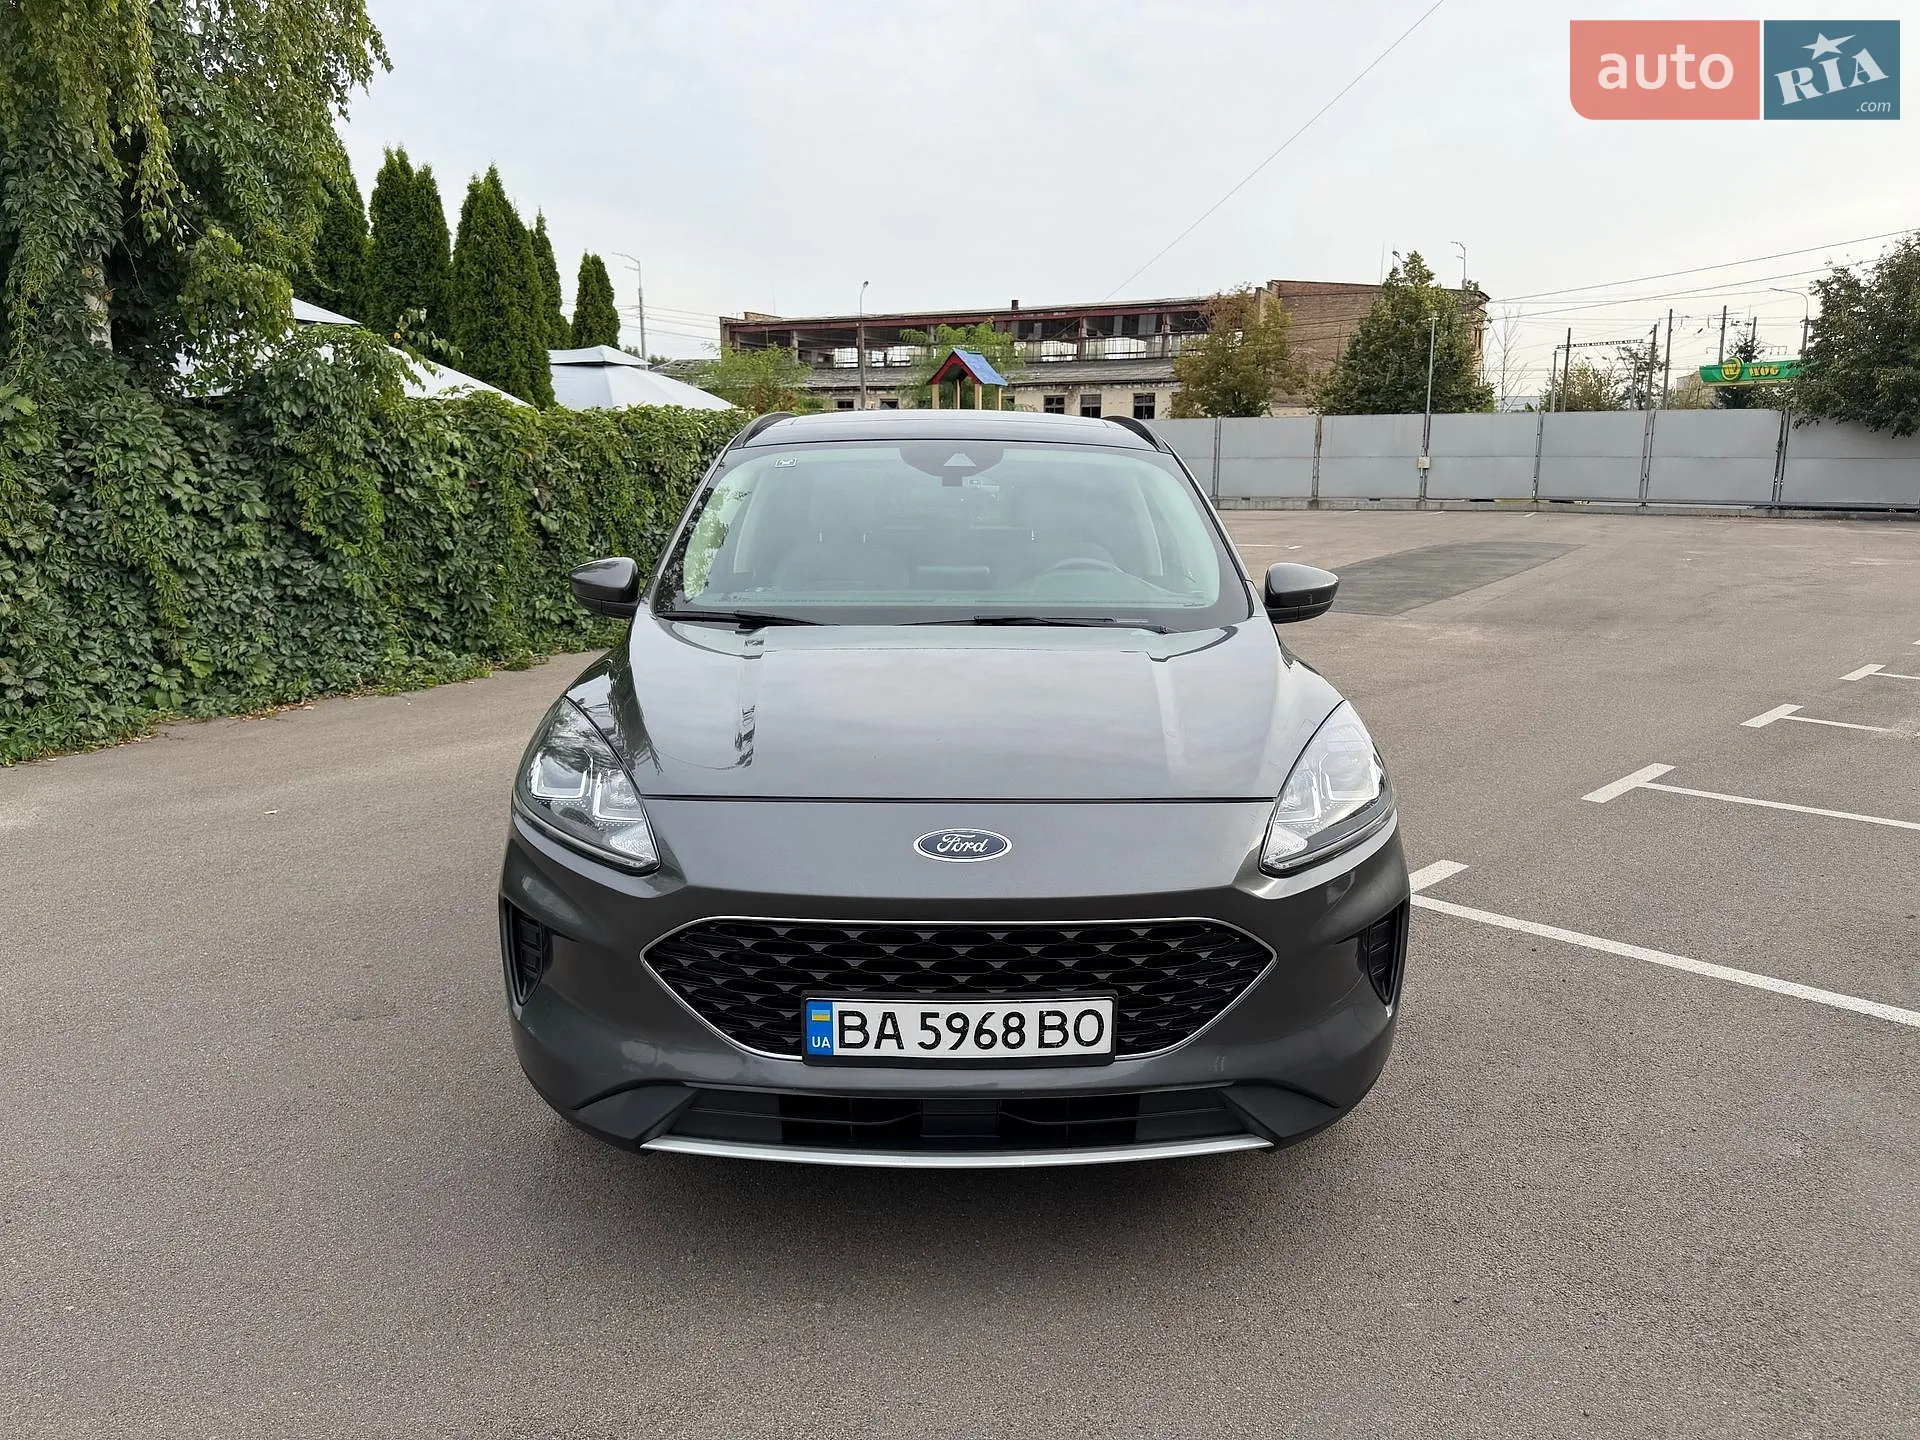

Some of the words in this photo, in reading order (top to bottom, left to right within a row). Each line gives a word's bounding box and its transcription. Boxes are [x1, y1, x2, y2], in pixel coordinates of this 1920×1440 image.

[936, 833, 989, 853] Ford
[837, 1009, 905, 1050] BA
[917, 1011, 1026, 1051] 5968
[1038, 1008, 1105, 1050] BO
[811, 1036, 831, 1049] UA
